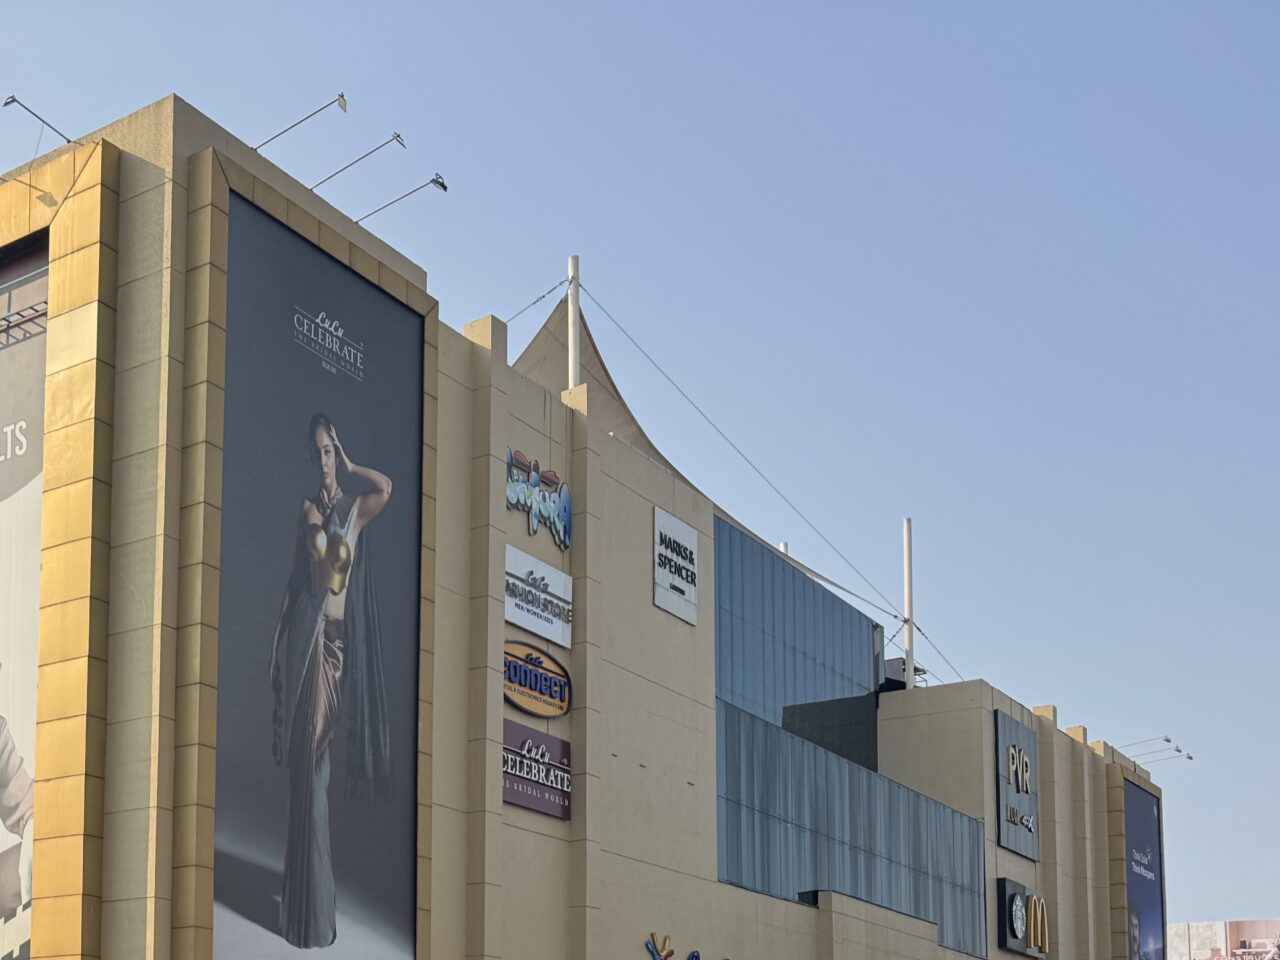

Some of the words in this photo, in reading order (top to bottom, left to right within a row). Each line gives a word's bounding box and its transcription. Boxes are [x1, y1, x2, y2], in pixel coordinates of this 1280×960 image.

[294, 314, 363, 368] CELEBRATE
[315, 312, 344, 338] LuLu
[660, 530, 689, 561] MARKS
[689, 550, 695, 566] &
[523, 570, 549, 592] LuLu
[658, 553, 696, 587] SPENCER
[522, 739, 551, 763] LuLu
[503, 752, 571, 792] CELEBRATE
[1007, 744, 1031, 794] PVR
[513, 782, 540, 798] BRIDAL
[545, 791, 569, 807] WORLD
